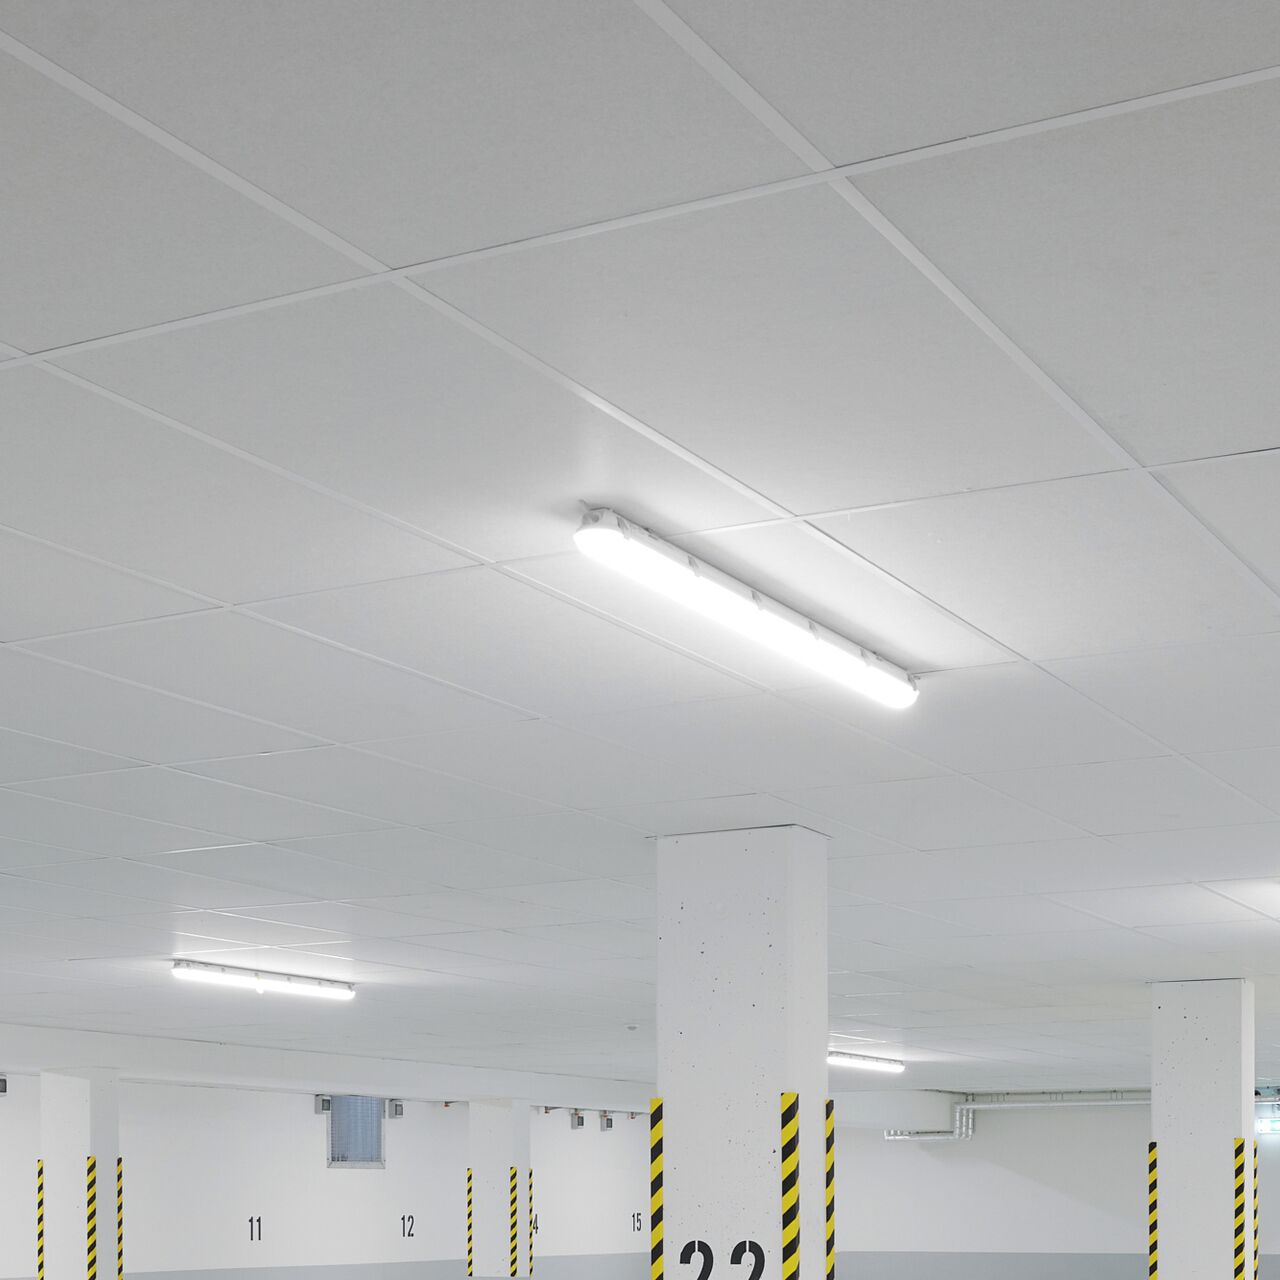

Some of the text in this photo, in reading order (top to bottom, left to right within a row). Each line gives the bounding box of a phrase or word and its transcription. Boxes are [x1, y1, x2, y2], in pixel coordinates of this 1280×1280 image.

[248, 1215, 262, 1241] 11
[401, 1214, 414, 1238] 12
[533, 1213, 539, 1235] 4
[631, 1212, 642, 1232] 15
